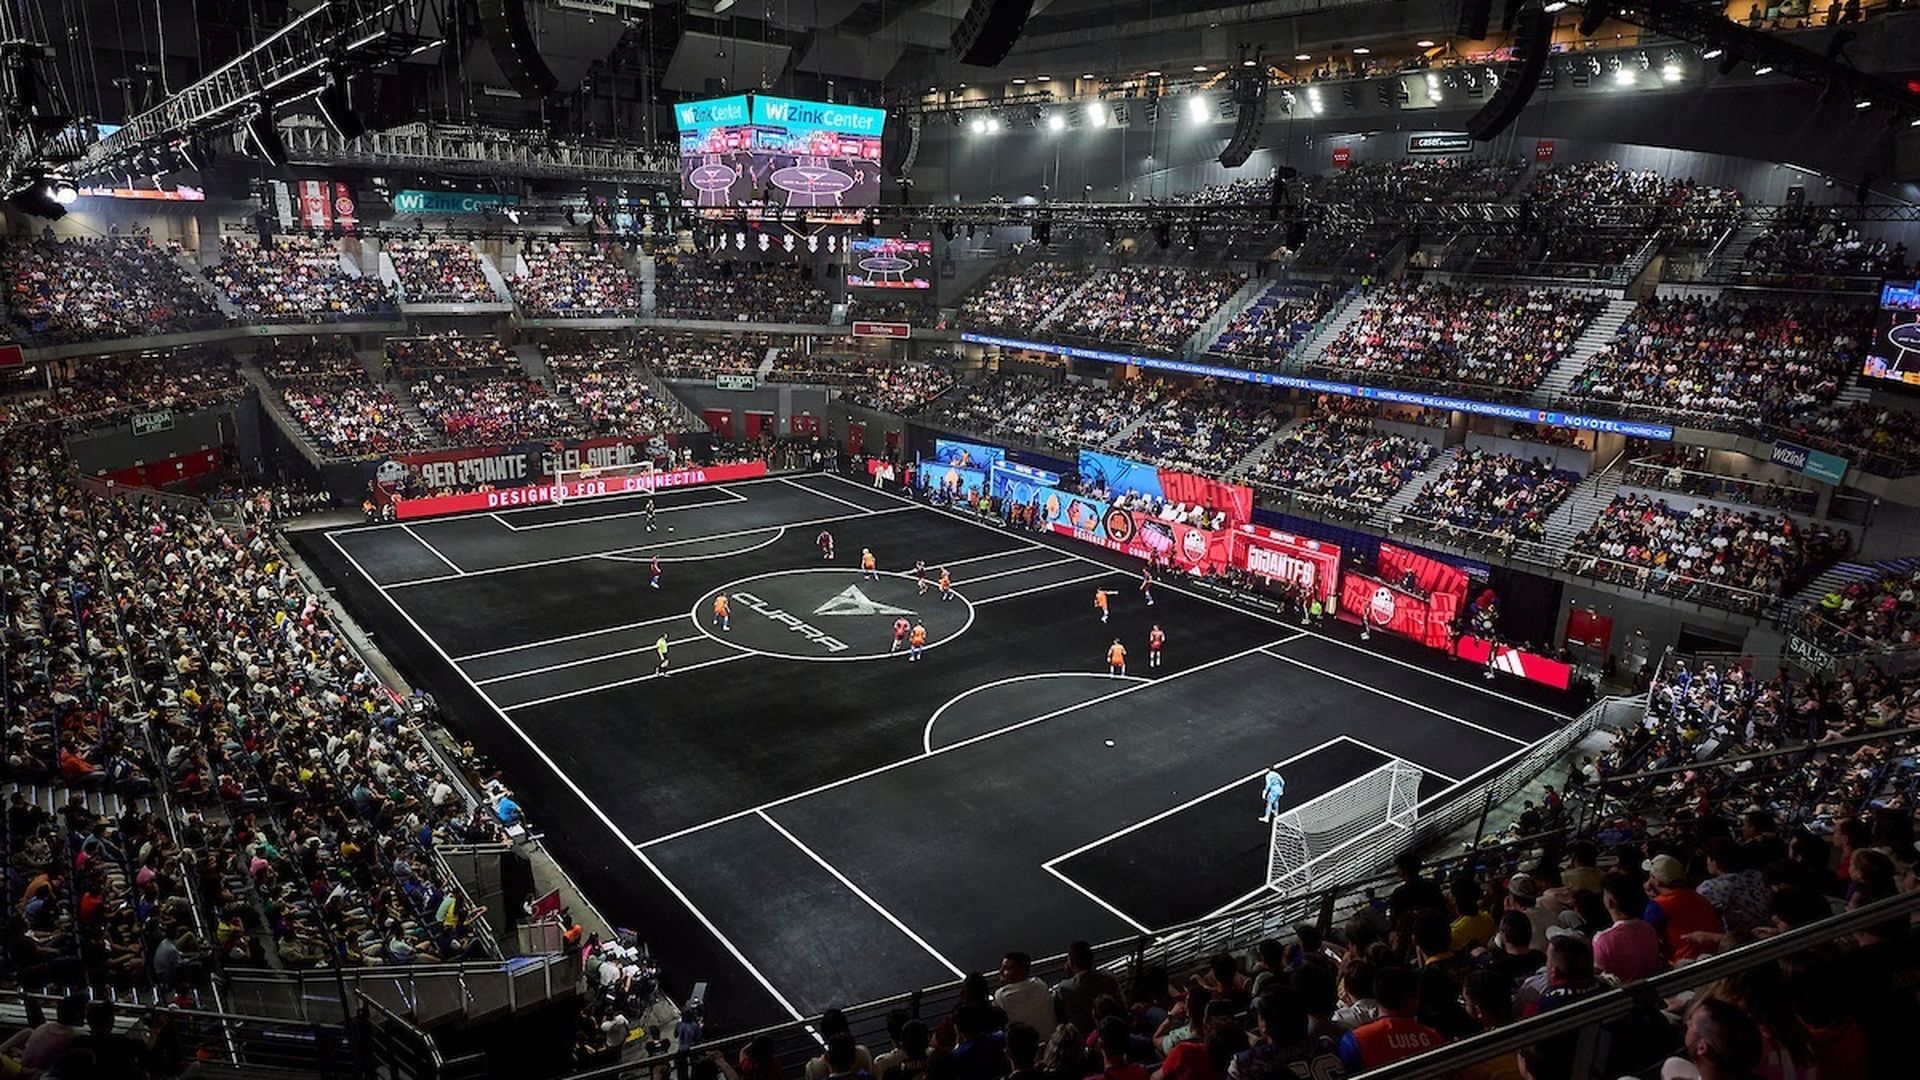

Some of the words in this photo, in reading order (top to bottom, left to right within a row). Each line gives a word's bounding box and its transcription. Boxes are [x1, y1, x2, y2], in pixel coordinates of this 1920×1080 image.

[1273, 376, 1309, 388] NOVOTEL
[135, 413, 171, 428] SALIDA
[1501, 407, 1530, 419] LEAGUE
[1564, 415, 1619, 432] NOVOTEL
[422, 462, 457, 488] SER
[488, 485, 569, 507] DESIGNED
[577, 481, 607, 496] FOR
[732, 592, 849, 652] CUPRA
[1790, 637, 1836, 674] SALIDA
